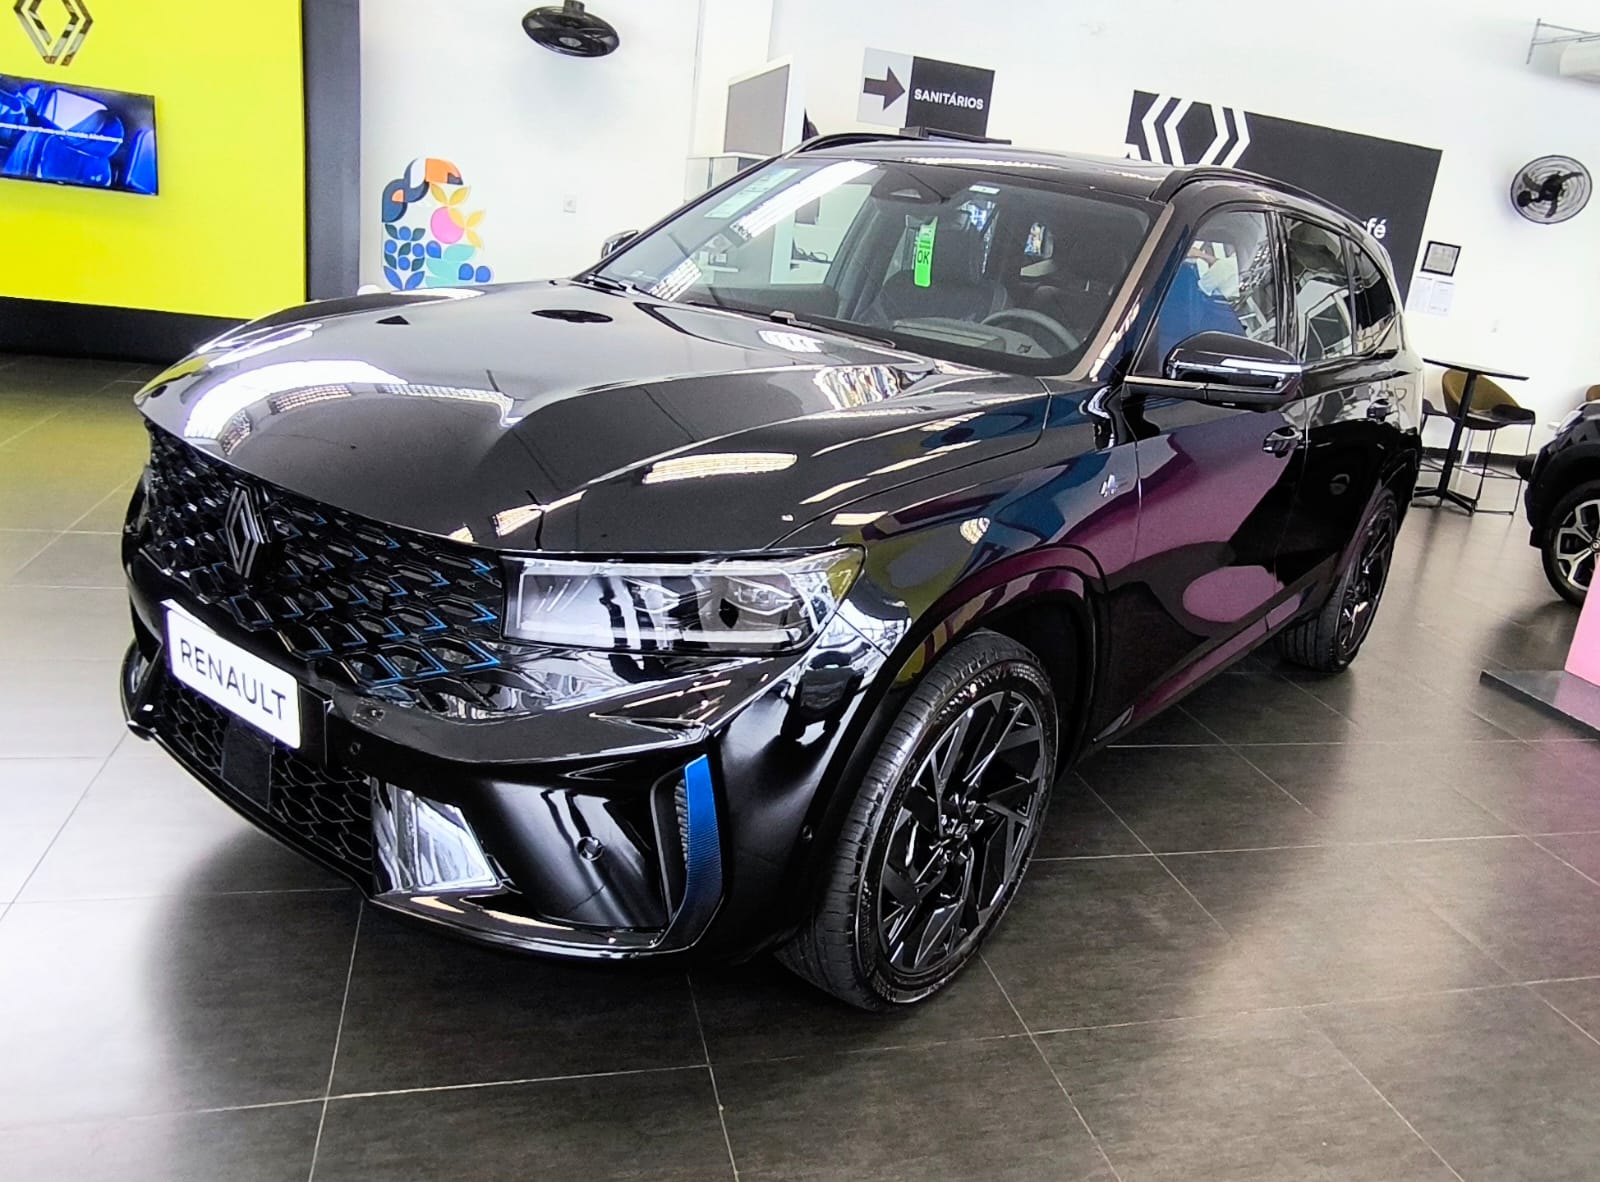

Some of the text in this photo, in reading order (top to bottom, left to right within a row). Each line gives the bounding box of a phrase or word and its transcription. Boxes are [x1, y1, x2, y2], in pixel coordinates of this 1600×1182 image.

[914, 88, 984, 110] SANITÁRIOS
[1362, 217, 1387, 239] fé
[917, 250, 930, 265] OK
[180, 638, 286, 720] RENAULT
